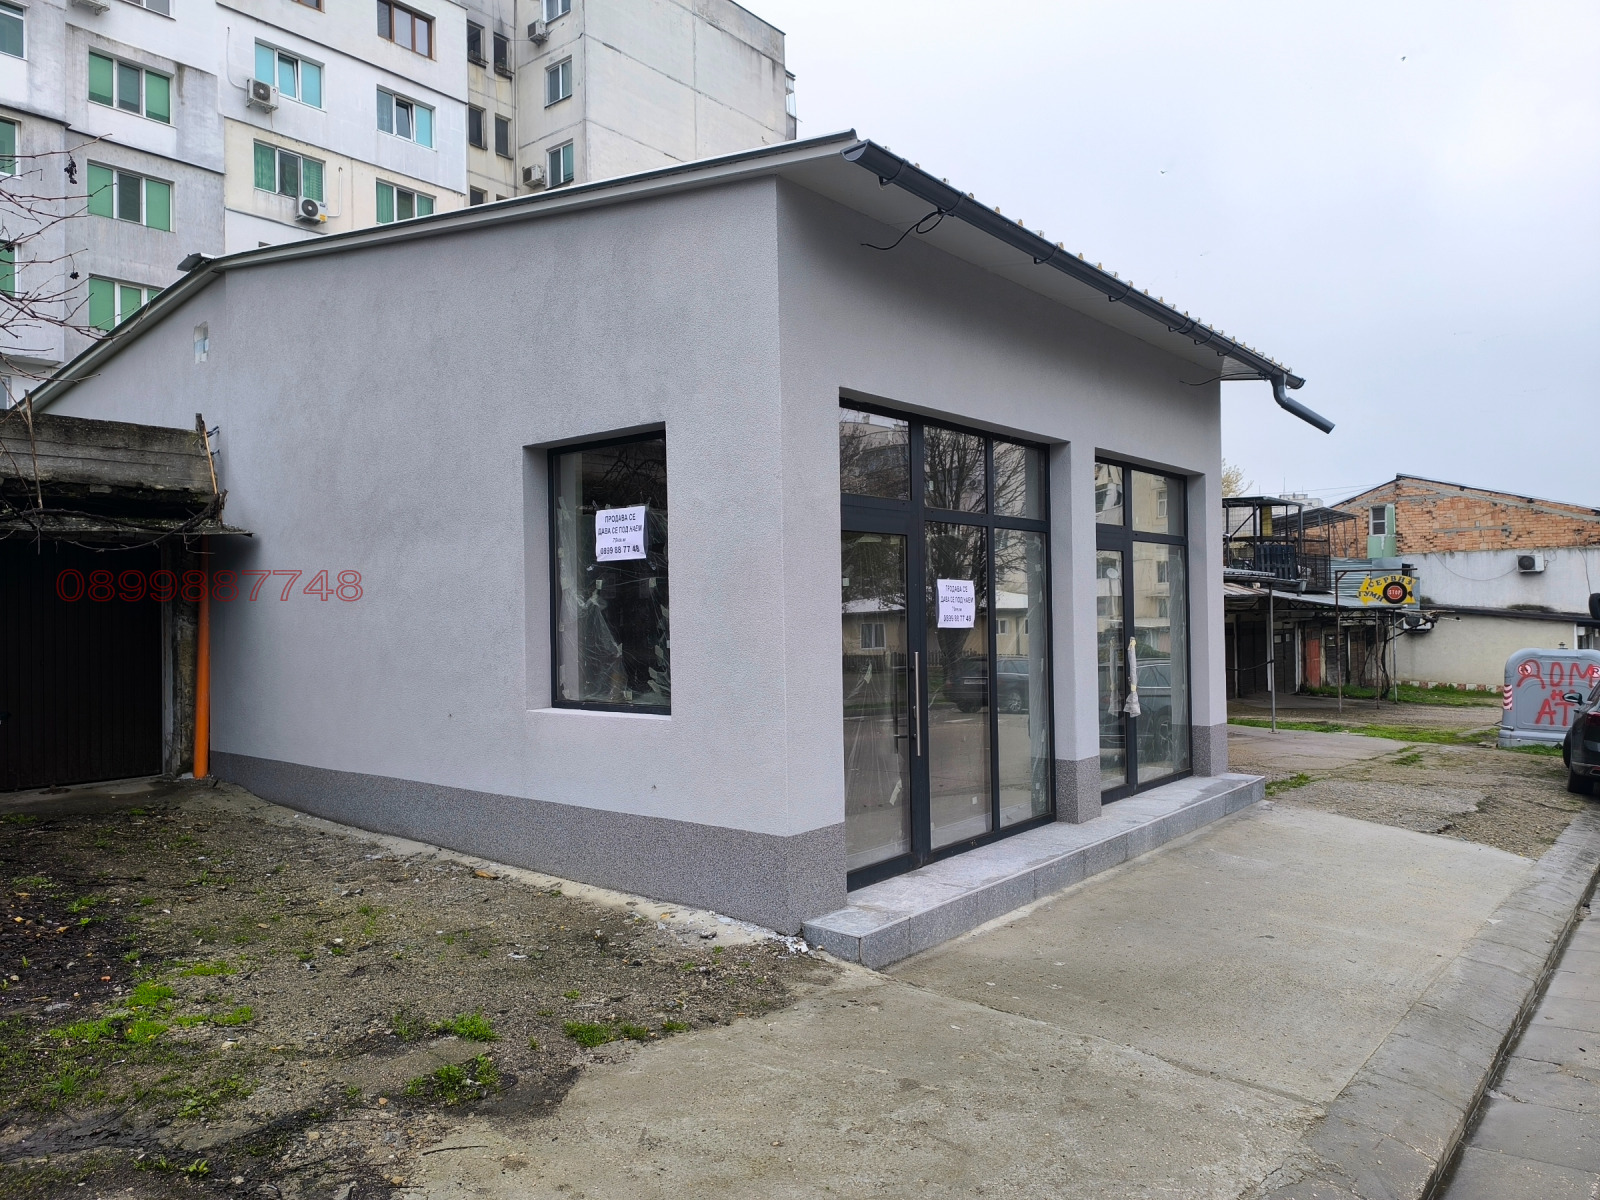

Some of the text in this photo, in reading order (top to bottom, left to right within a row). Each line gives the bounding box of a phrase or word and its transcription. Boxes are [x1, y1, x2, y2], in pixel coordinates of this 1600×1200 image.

[605, 513, 636, 523] ПРОДАВА СЕ
[598, 528, 611, 536] ДАВА
[619, 526, 629, 534] ПОД
[1368, 575, 1412, 587] СЕРВИЗ
[1358, 591, 1384, 602] ГУМИ
